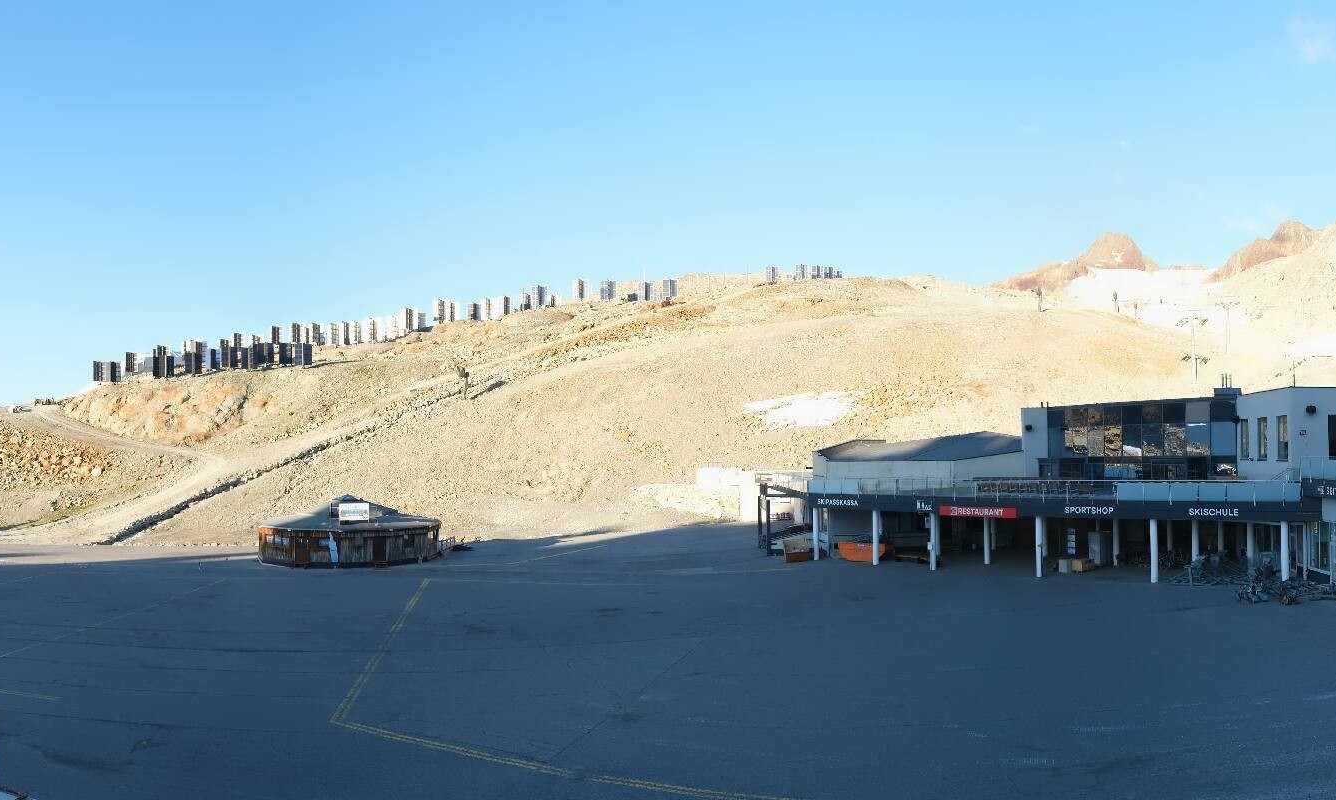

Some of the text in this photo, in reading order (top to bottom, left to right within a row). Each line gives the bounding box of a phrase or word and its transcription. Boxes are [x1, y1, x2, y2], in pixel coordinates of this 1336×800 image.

[817, 498, 859, 507] SKIPASSKASSA
[957, 507, 1004, 517] RESTAURANT
[1064, 506, 1114, 515] SPORTSHOP
[1189, 508, 1239, 517] SKISCHULE
